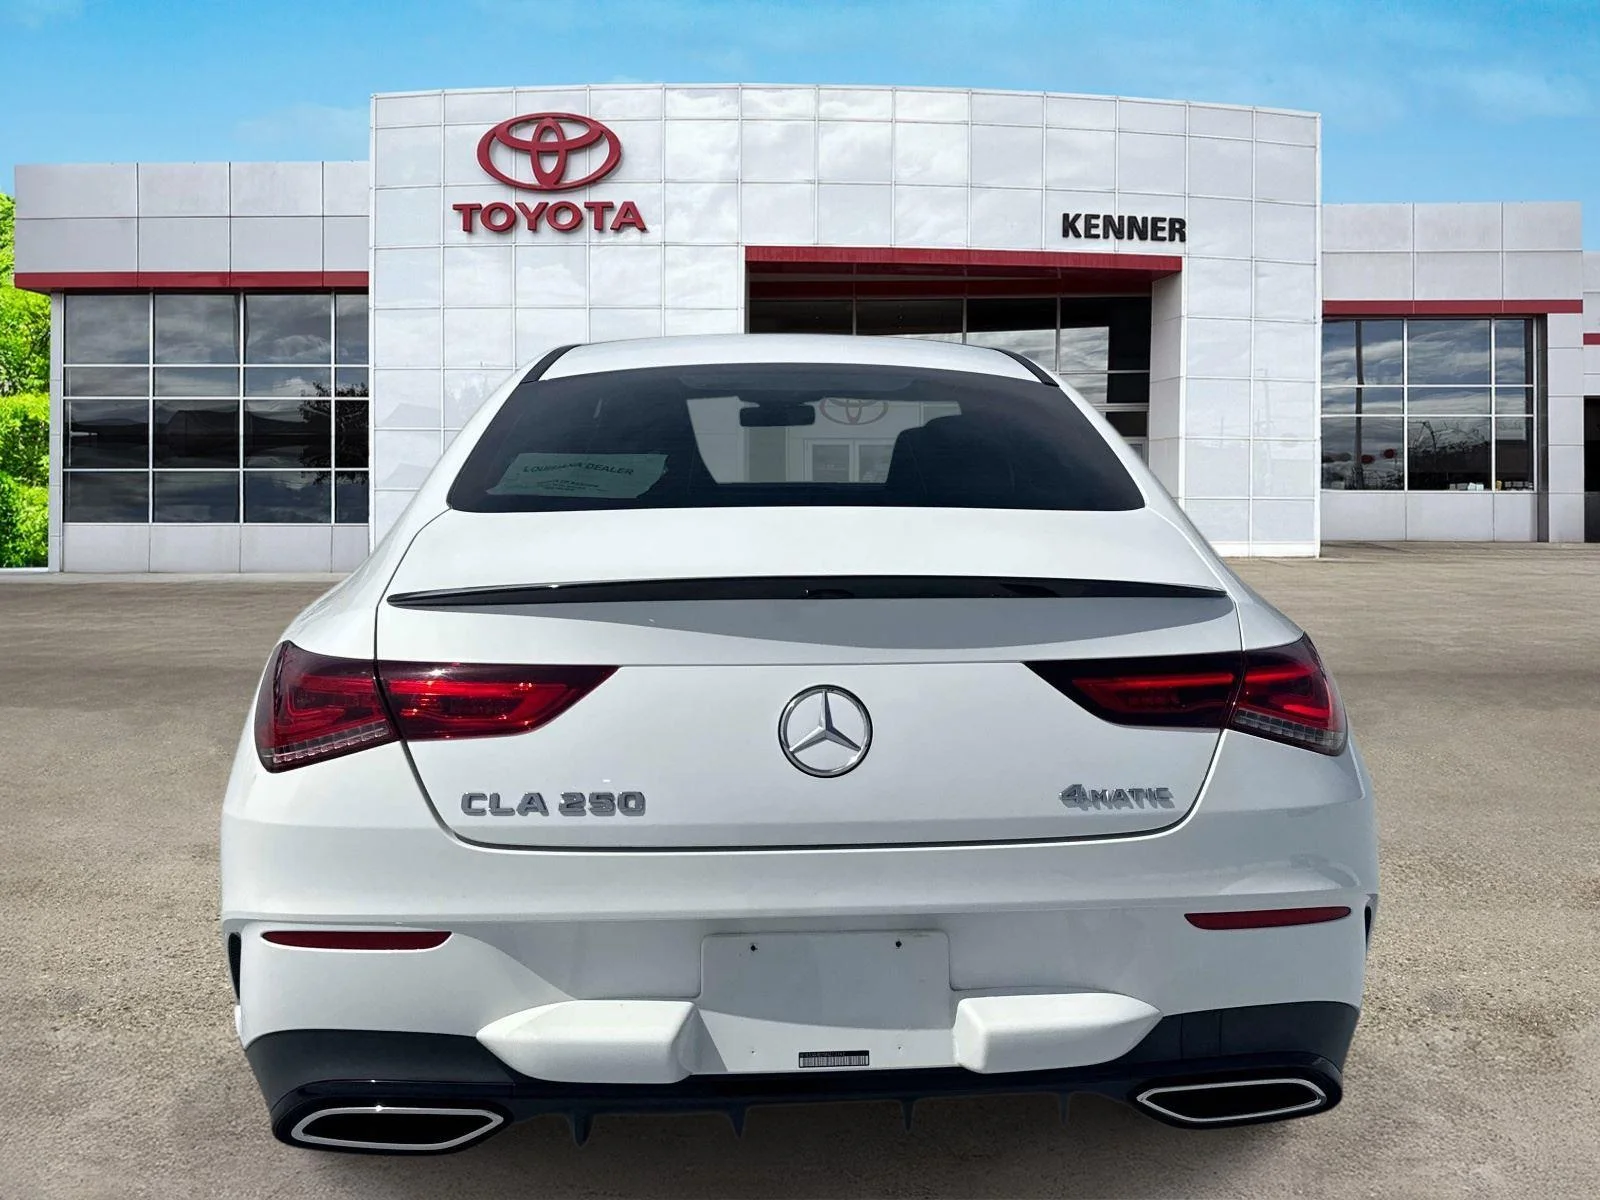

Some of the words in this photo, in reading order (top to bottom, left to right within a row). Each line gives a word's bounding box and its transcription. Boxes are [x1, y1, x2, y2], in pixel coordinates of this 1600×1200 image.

[453, 201, 647, 232] TOYOTA
[1062, 213, 1186, 242] KENNER
[585, 463, 634, 475] DEALER
[461, 792, 549, 816] CLA
[559, 792, 646, 816] 250
[1060, 784, 1174, 808] 4MATIC
